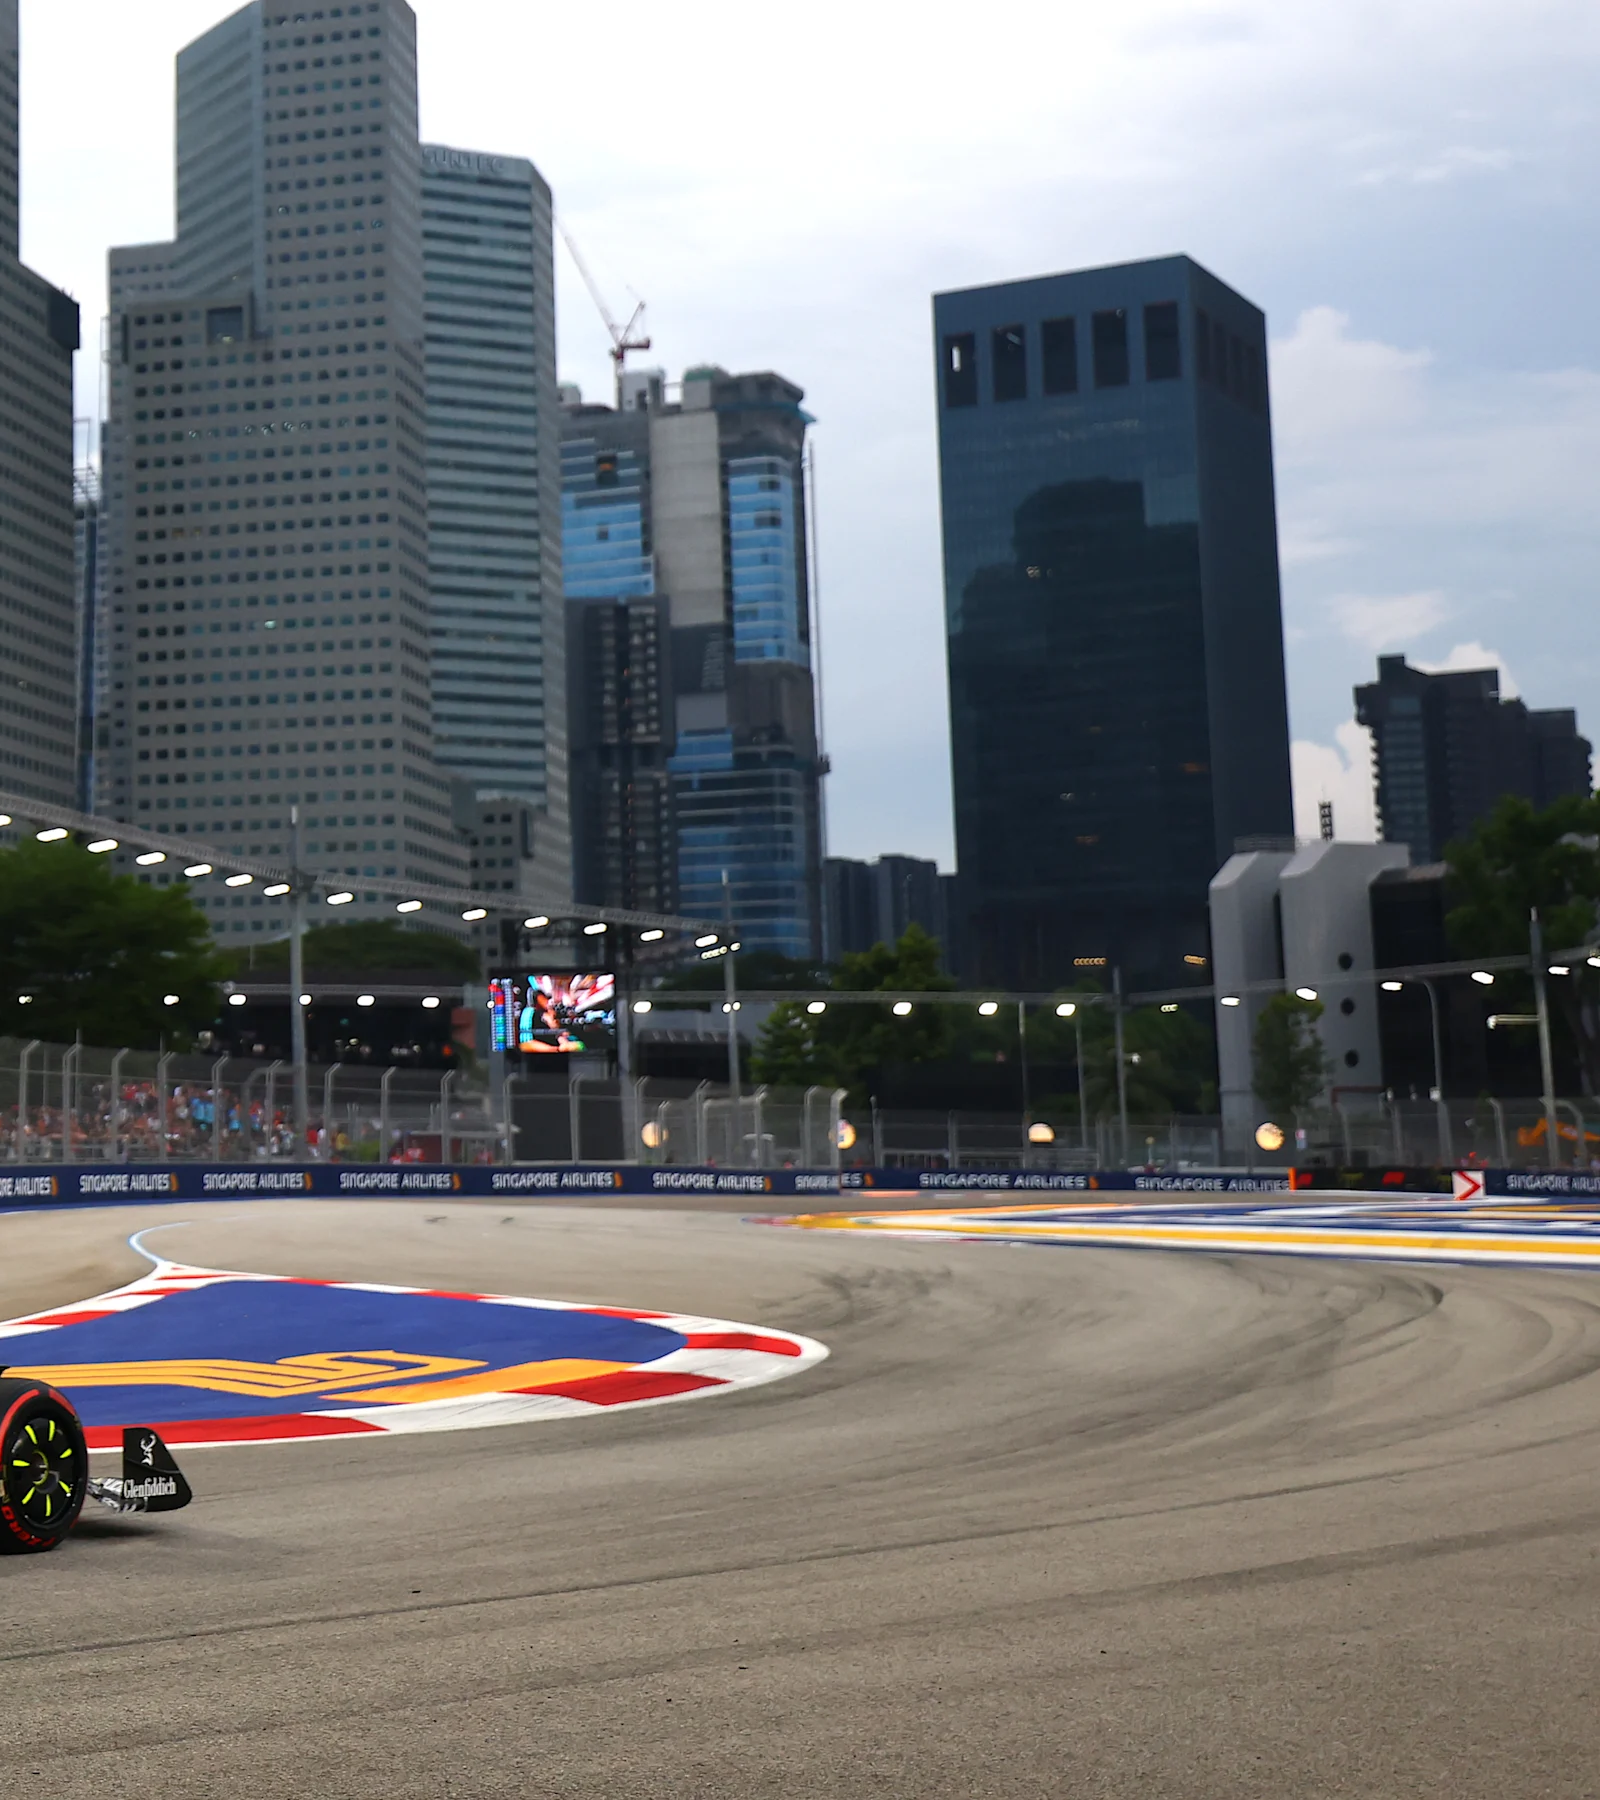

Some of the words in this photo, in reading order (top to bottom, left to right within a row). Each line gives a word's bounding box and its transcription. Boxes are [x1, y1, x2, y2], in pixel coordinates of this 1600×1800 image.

[13, 1176, 51, 1196] AIRLINES
[79, 1173, 129, 1193] SINGAPORE
[129, 1173, 170, 1191] AIRLINES
[203, 1173, 257, 1191] SINGAPORE
[257, 1172, 304, 1190] AIRLINES
[339, 1172, 398, 1189] SINGAPORE
[401, 1172, 451, 1189] AIRLINES
[491, 1172, 558, 1188] SINGAPORE
[560, 1171, 613, 1188] AIRLINES
[652, 1172, 715, 1189] SINGAPORE
[716, 1175, 765, 1191] AIRLINES
[919, 1173, 1010, 1188] SINGAPORE
[1014, 1175, 1086, 1189] AIRLINES
[1135, 1176, 1224, 1191] SINGAPORE
[1506, 1174, 1569, 1192] SINGAPORE
[123, 1475, 177, 1499] Glenfiddich
